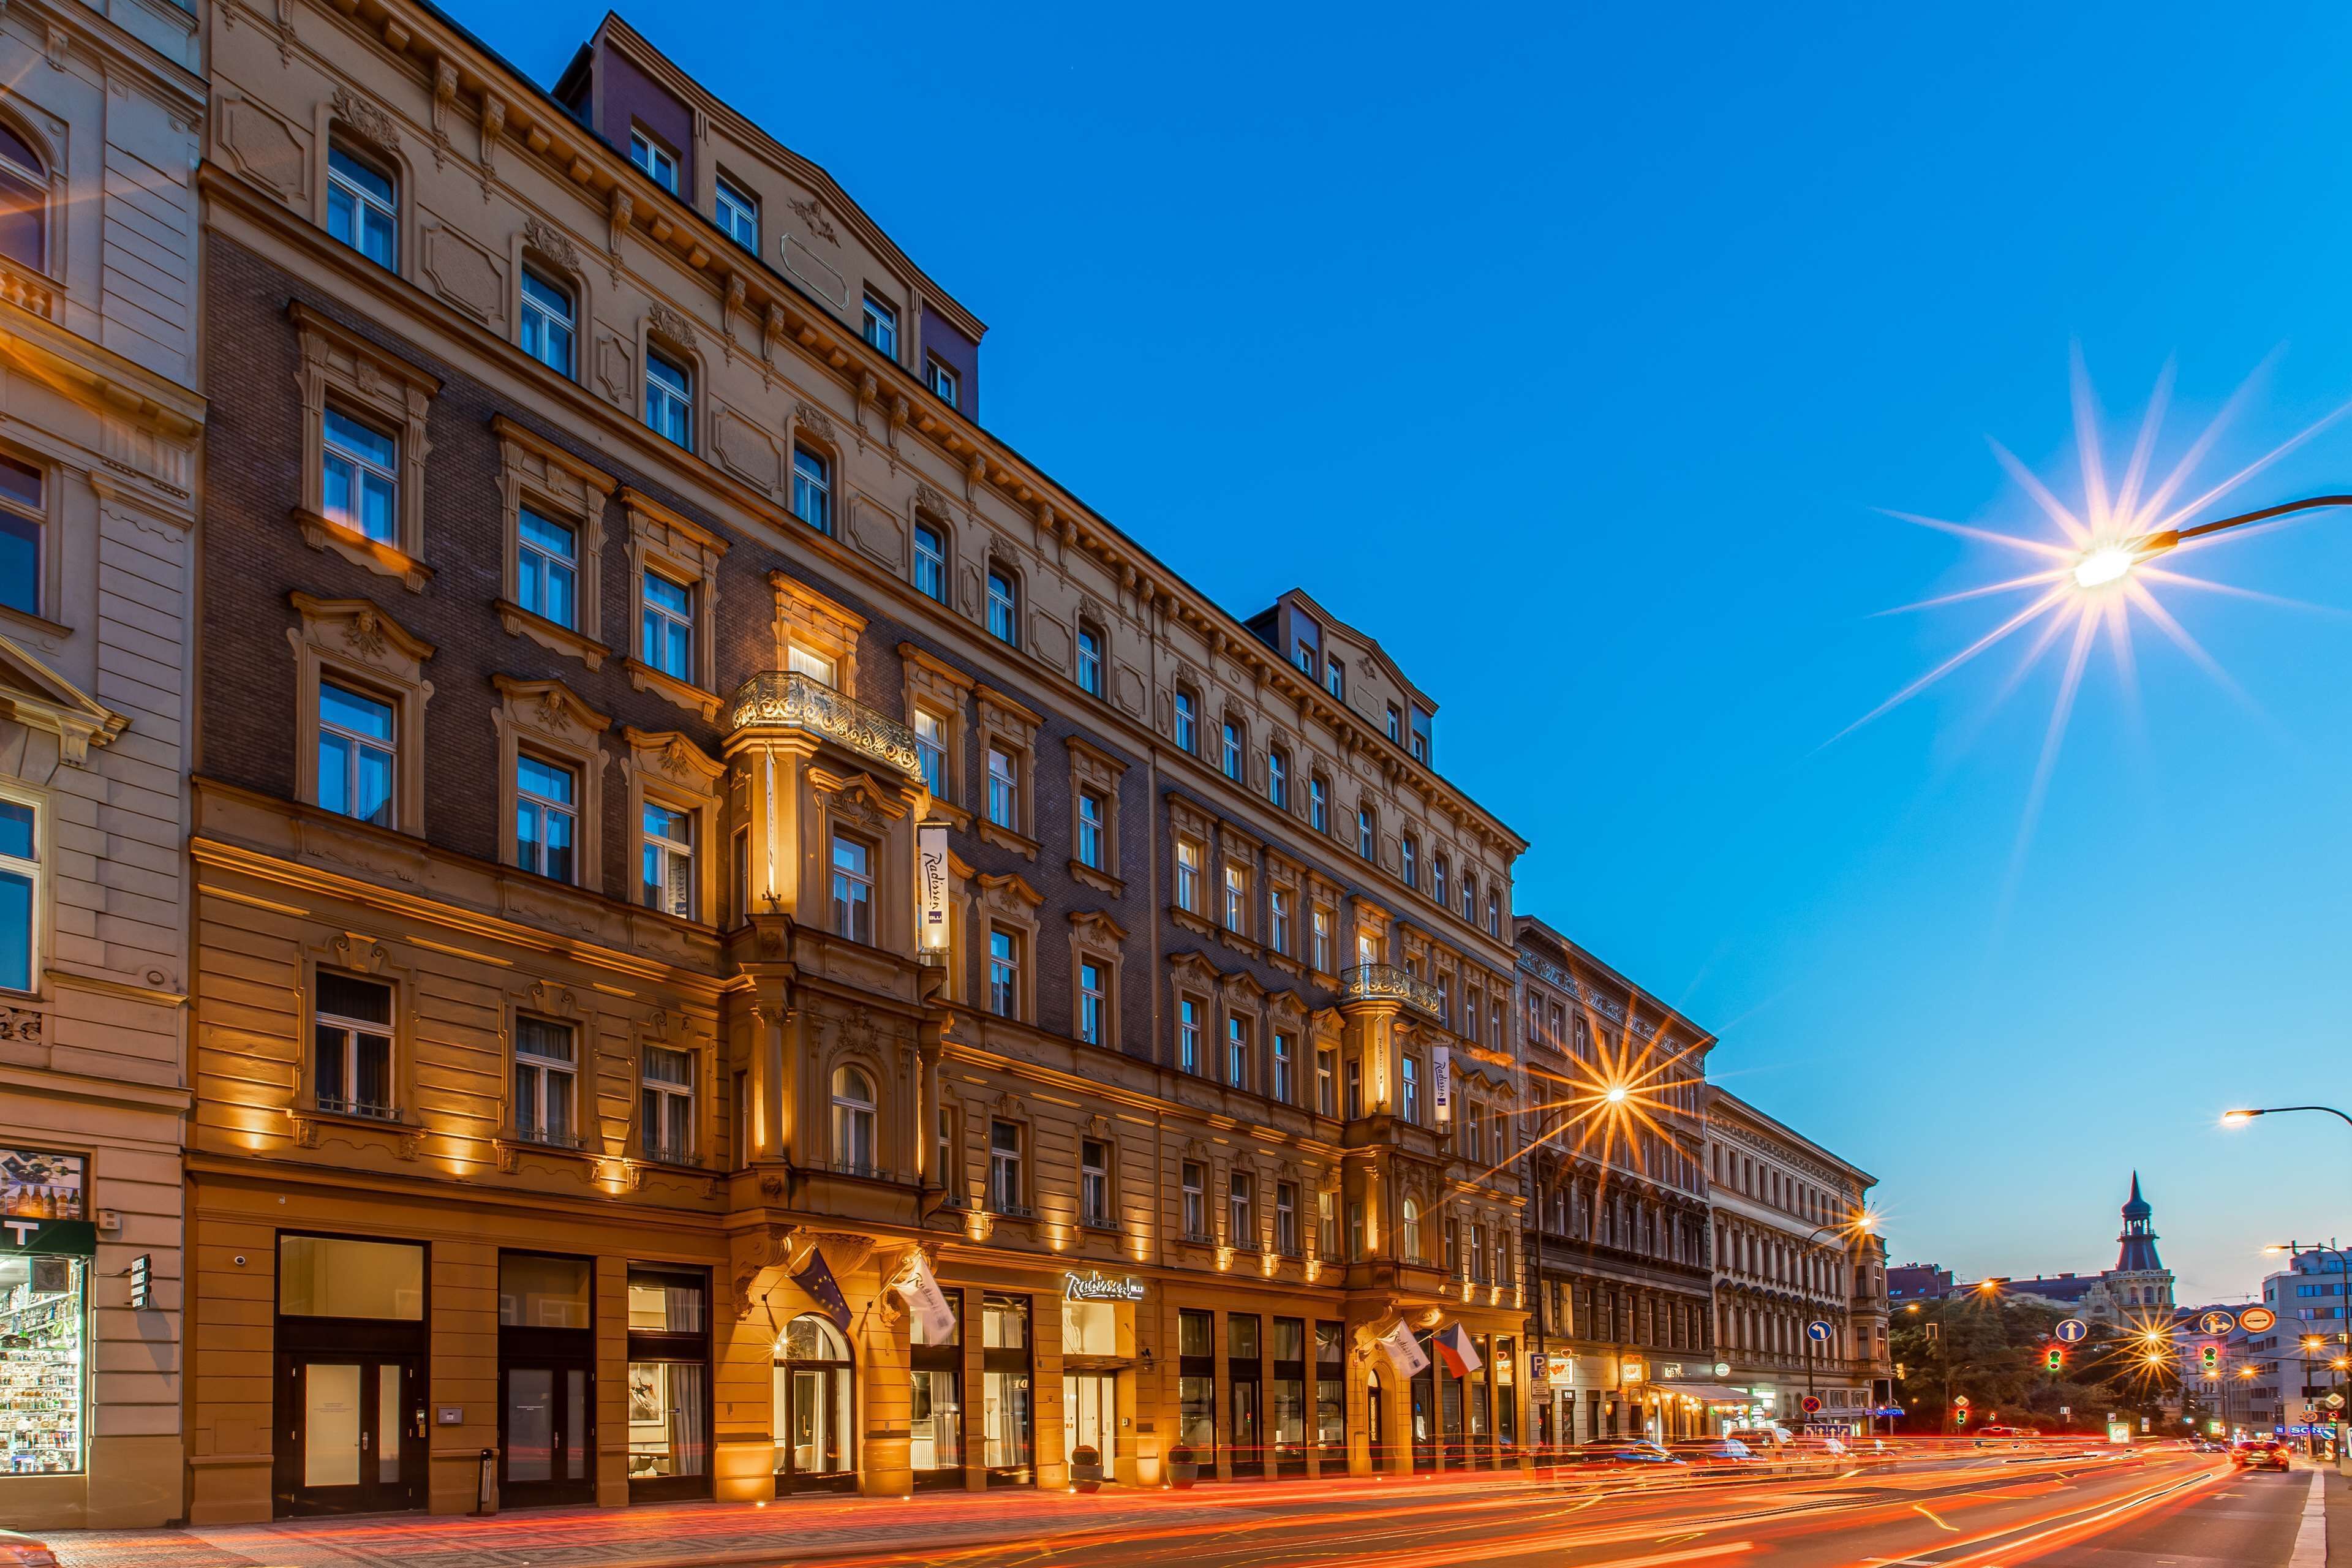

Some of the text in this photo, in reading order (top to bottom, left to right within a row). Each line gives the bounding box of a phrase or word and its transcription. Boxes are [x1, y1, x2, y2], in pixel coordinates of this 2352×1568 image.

[922, 852, 945, 910] Radisson
[1434, 1061, 1448, 1097] Radisson
[4, 1220, 40, 1245] T
[1065, 1270, 1128, 1302] Radisson
[1534, 1356, 1545, 1371] P
